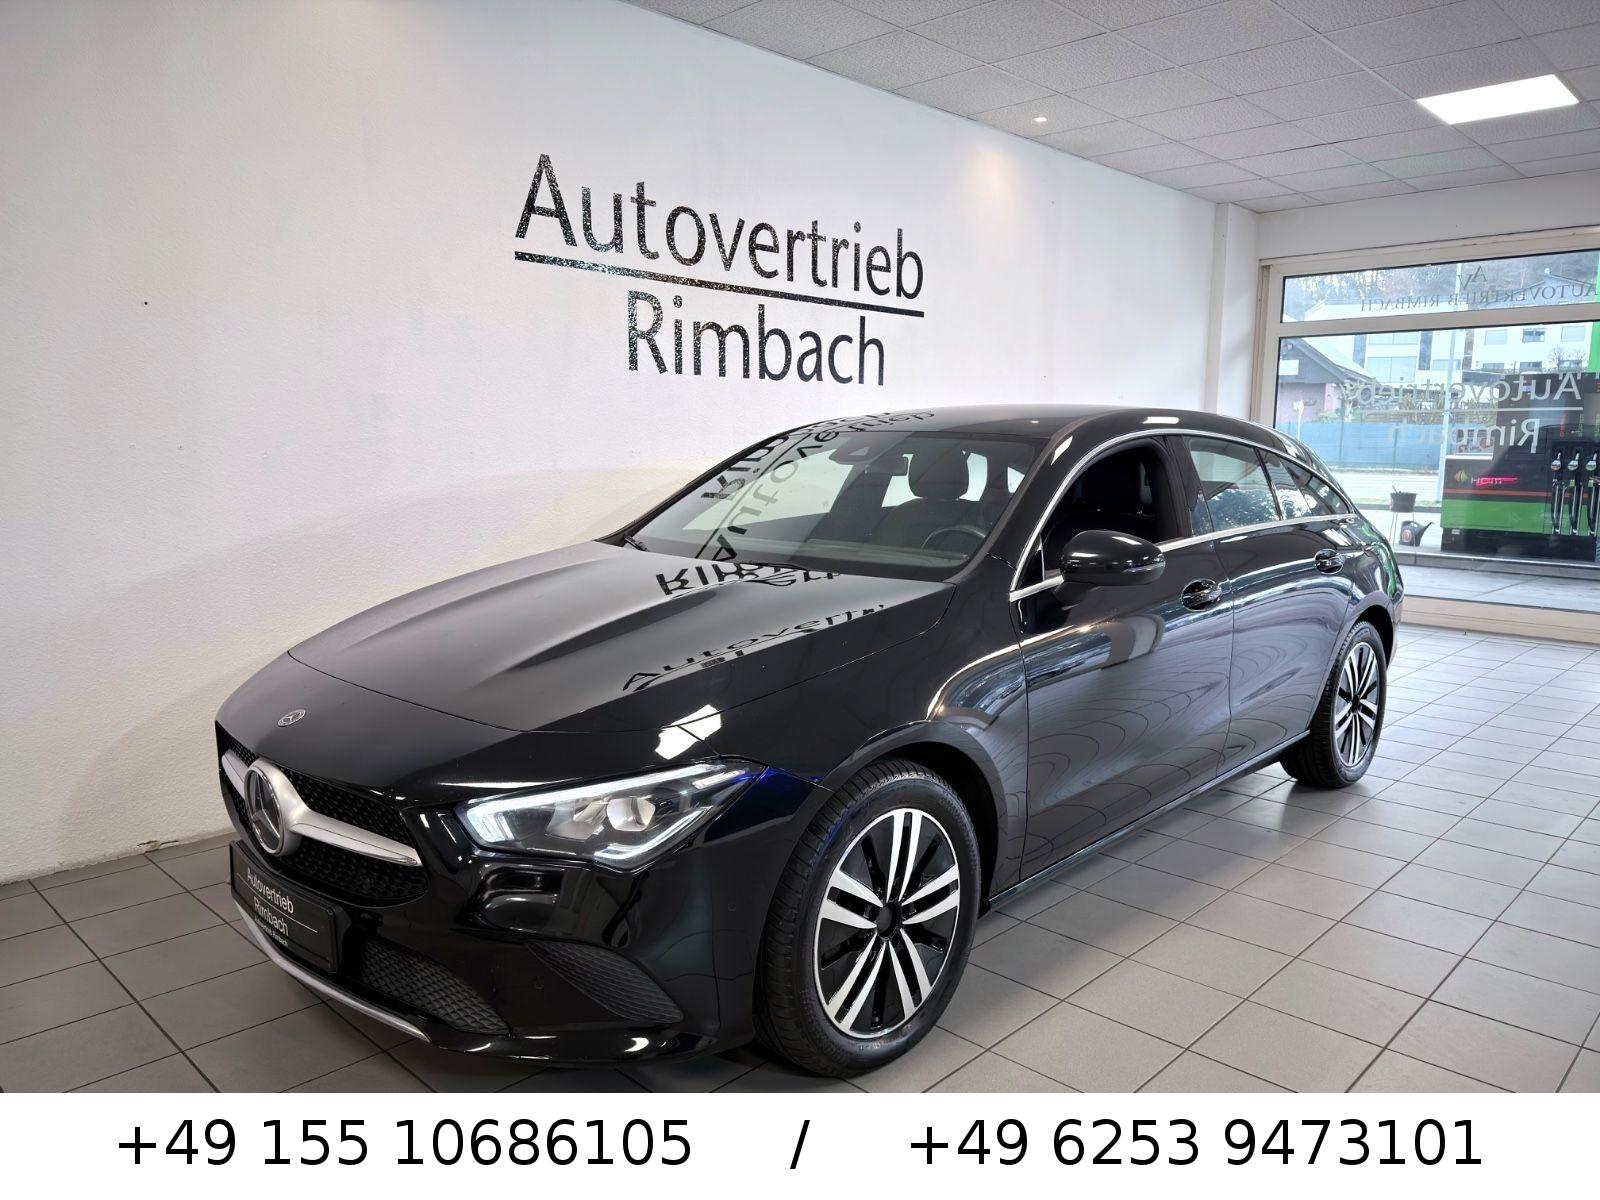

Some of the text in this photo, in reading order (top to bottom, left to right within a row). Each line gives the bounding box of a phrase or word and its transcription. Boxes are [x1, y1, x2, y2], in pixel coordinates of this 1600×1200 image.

[515, 153, 924, 300] Autovertrieb
[628, 290, 885, 386] Rimbach
[247, 867, 294, 914] Autovertrieb
[253, 896, 289, 937] Rimbach
